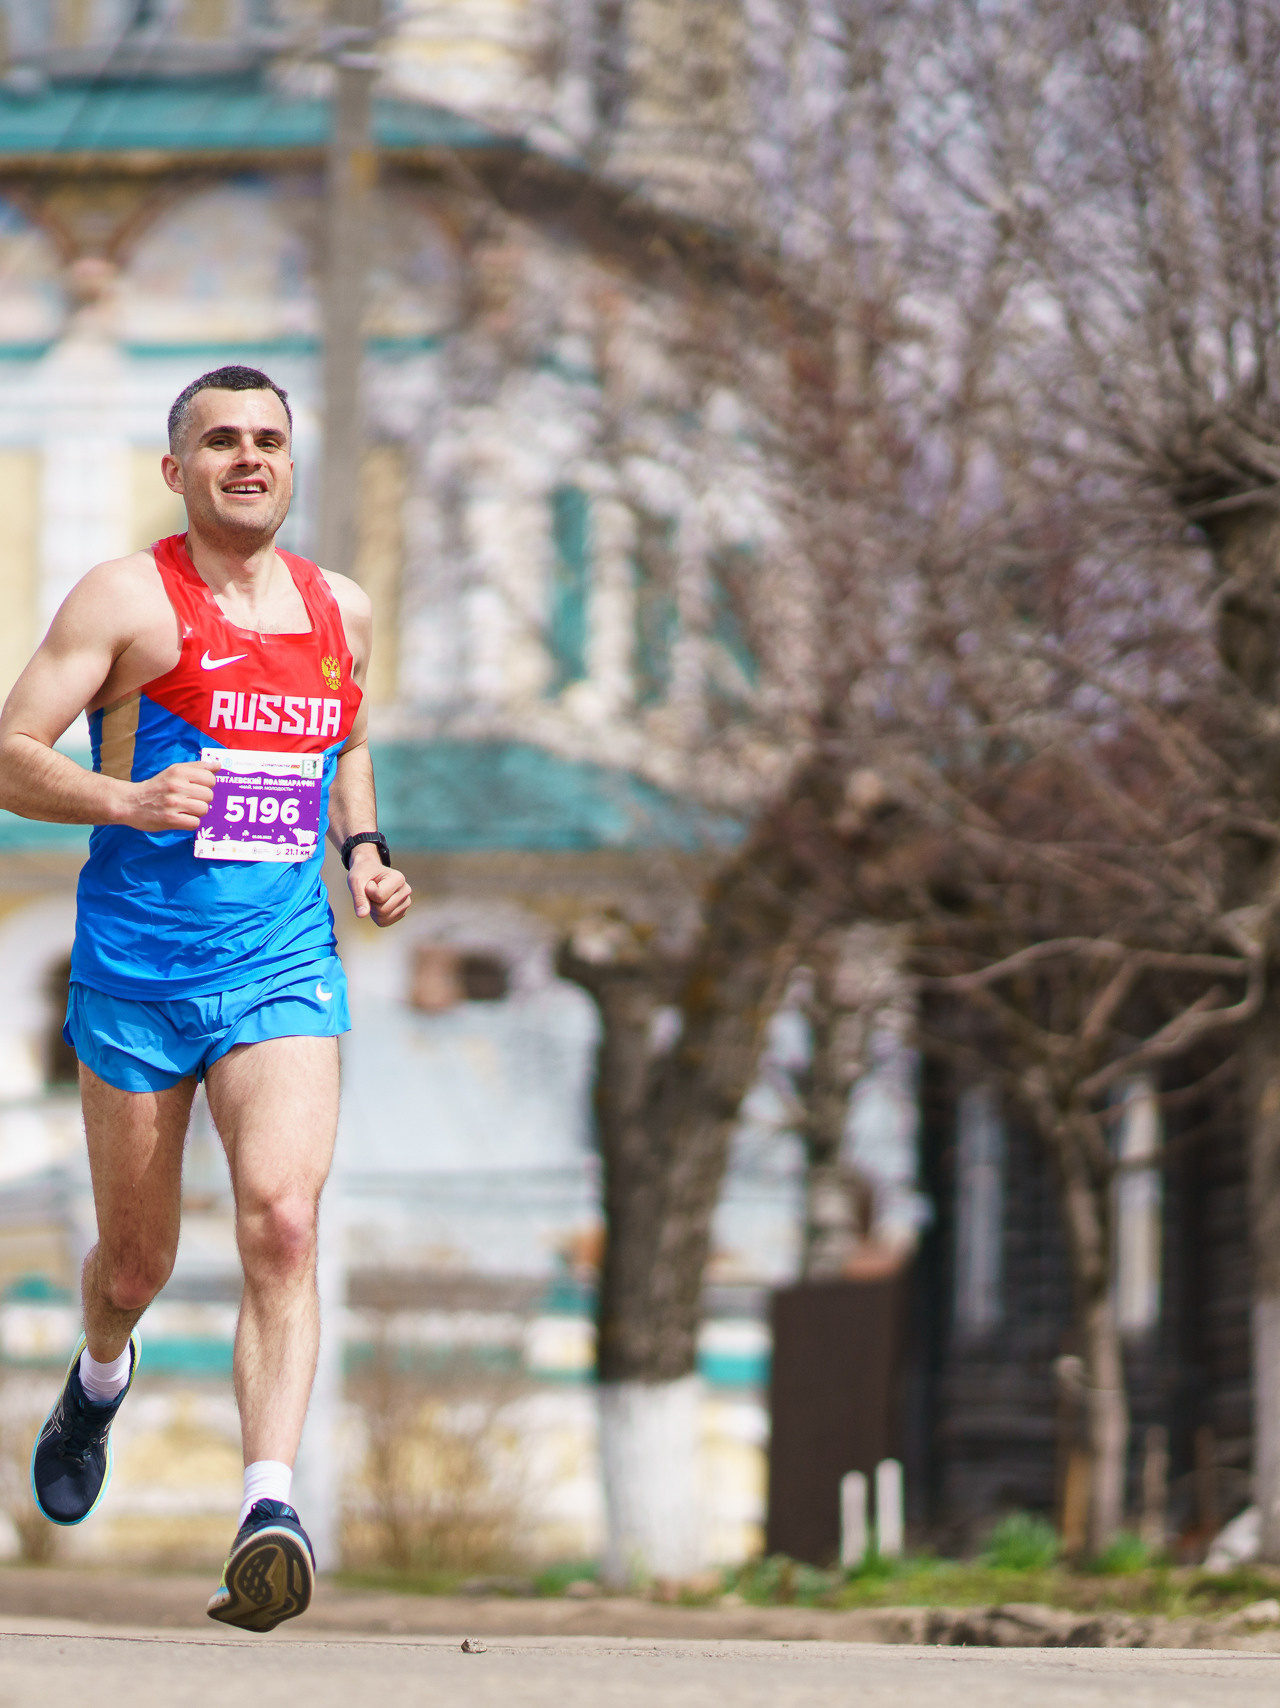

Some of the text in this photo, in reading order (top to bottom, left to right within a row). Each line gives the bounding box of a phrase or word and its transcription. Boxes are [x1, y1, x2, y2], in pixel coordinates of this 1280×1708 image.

[209, 690, 342, 737] RUSSIA
[215, 775, 315, 788] ТУТАЕВСКИЙ ПОЛУМАРАФОН
[223, 795, 300, 825] 5196
[285, 848, 298, 856] 21.1
